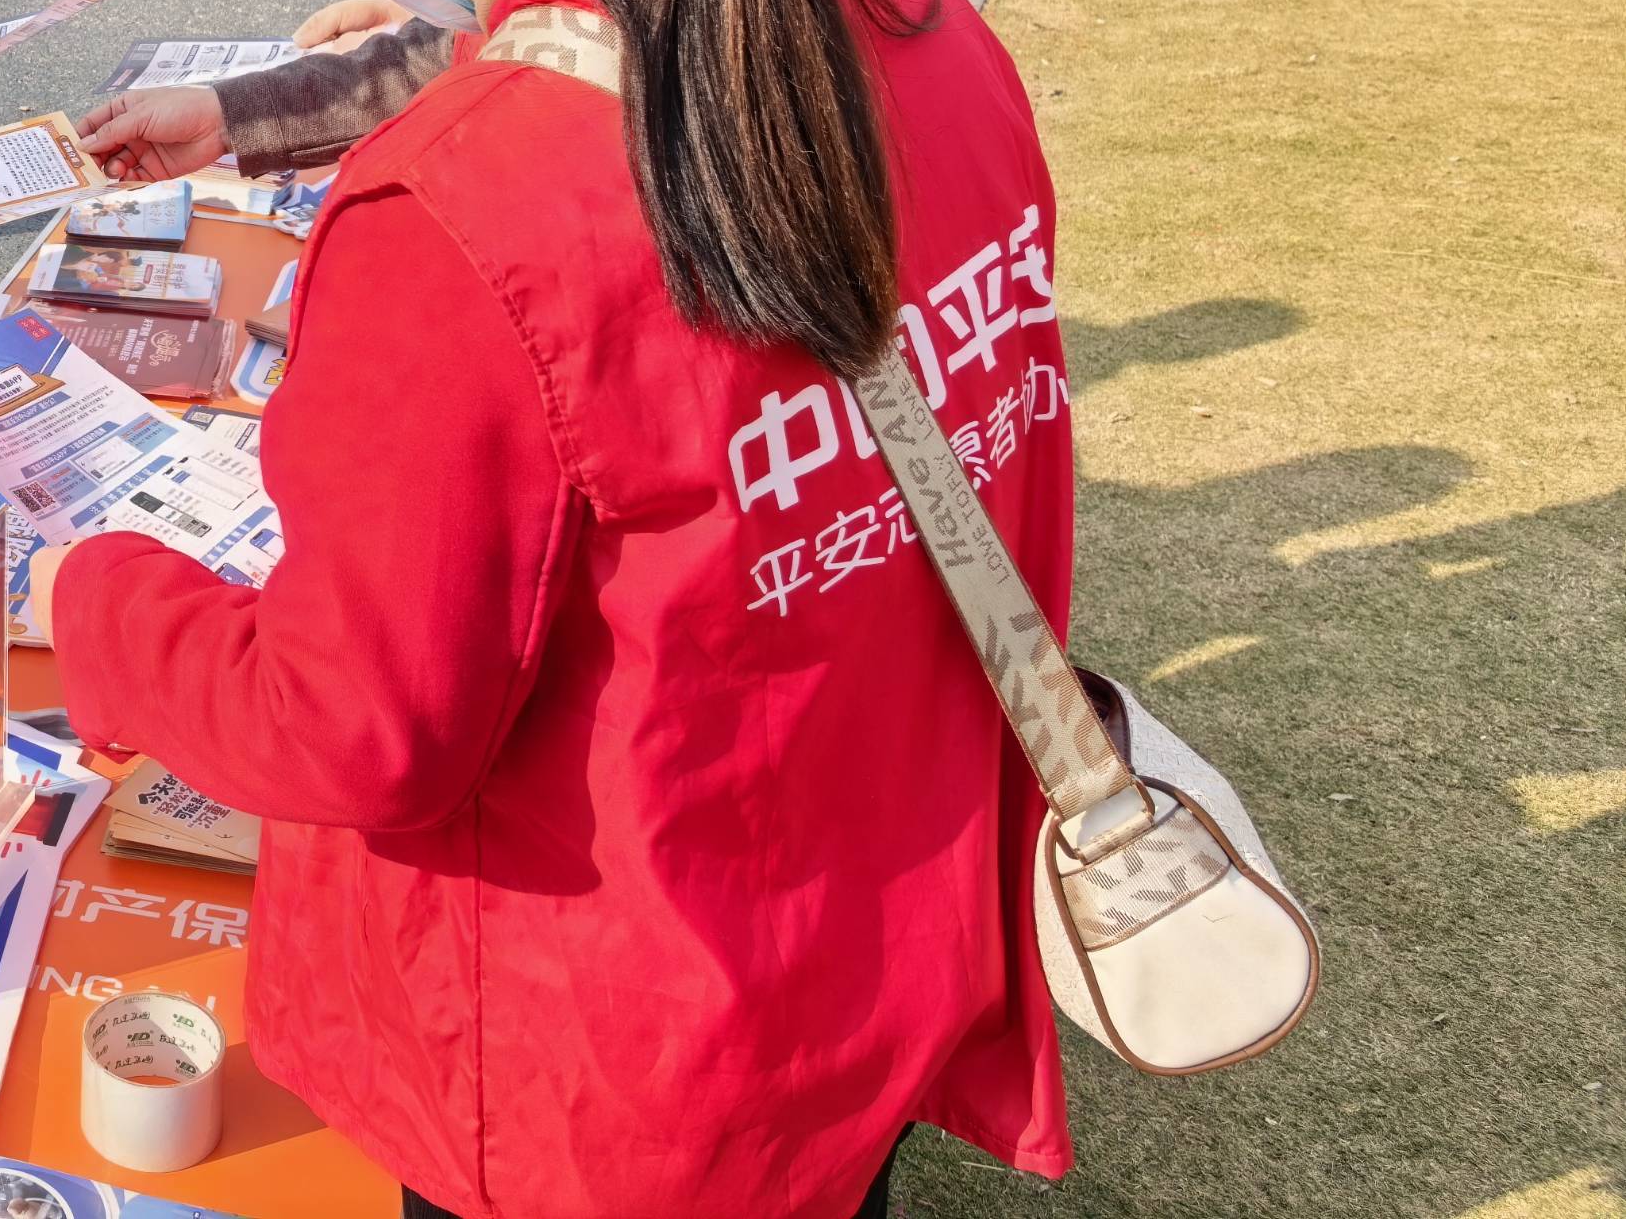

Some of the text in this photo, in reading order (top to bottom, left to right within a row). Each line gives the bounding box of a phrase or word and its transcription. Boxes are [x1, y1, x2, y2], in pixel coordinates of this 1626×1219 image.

[898, 378, 936, 440] LOVE
[907, 457, 974, 568] Have
[972, 523, 1011, 585] LOVE
